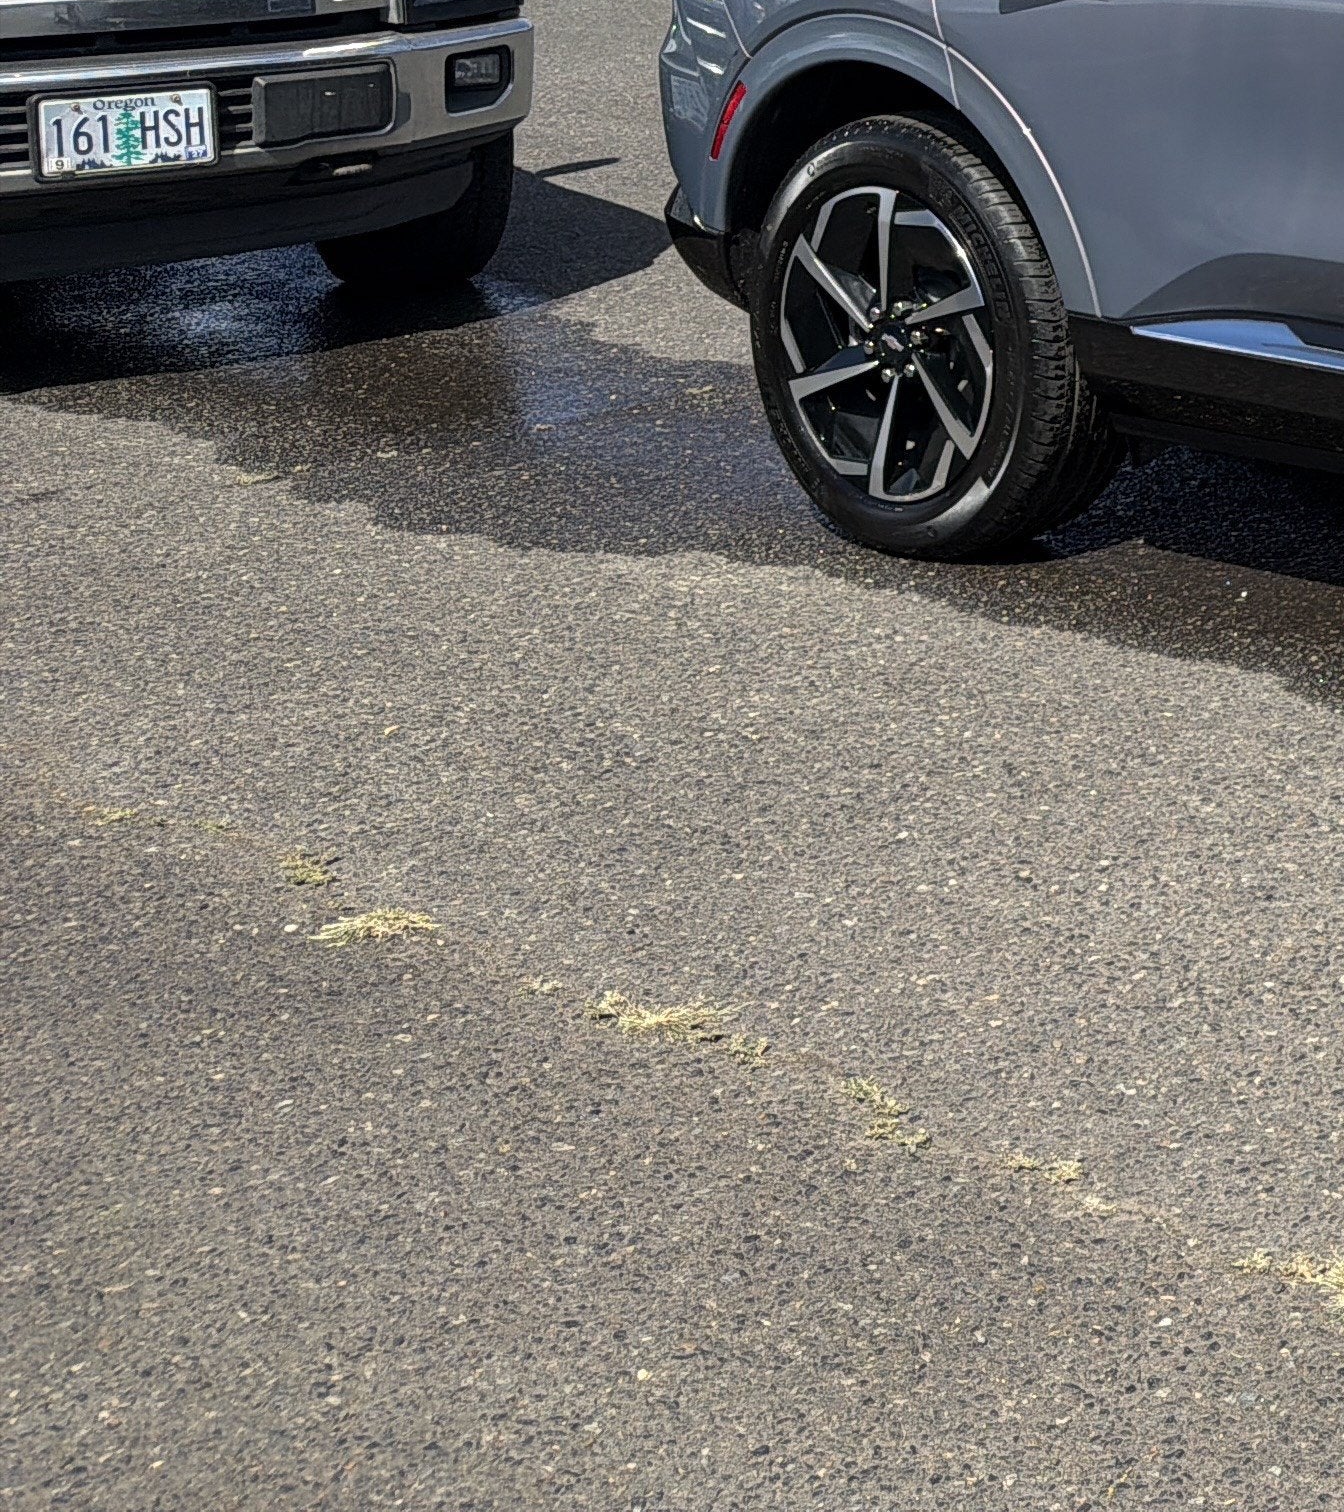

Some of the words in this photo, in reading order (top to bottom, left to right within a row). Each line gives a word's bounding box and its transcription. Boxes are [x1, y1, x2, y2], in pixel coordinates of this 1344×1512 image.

[92, 96, 157, 112] Oregon
[51, 113, 111, 158] 161
[139, 105, 206, 151] HSH
[54, 159, 65, 171] 9
